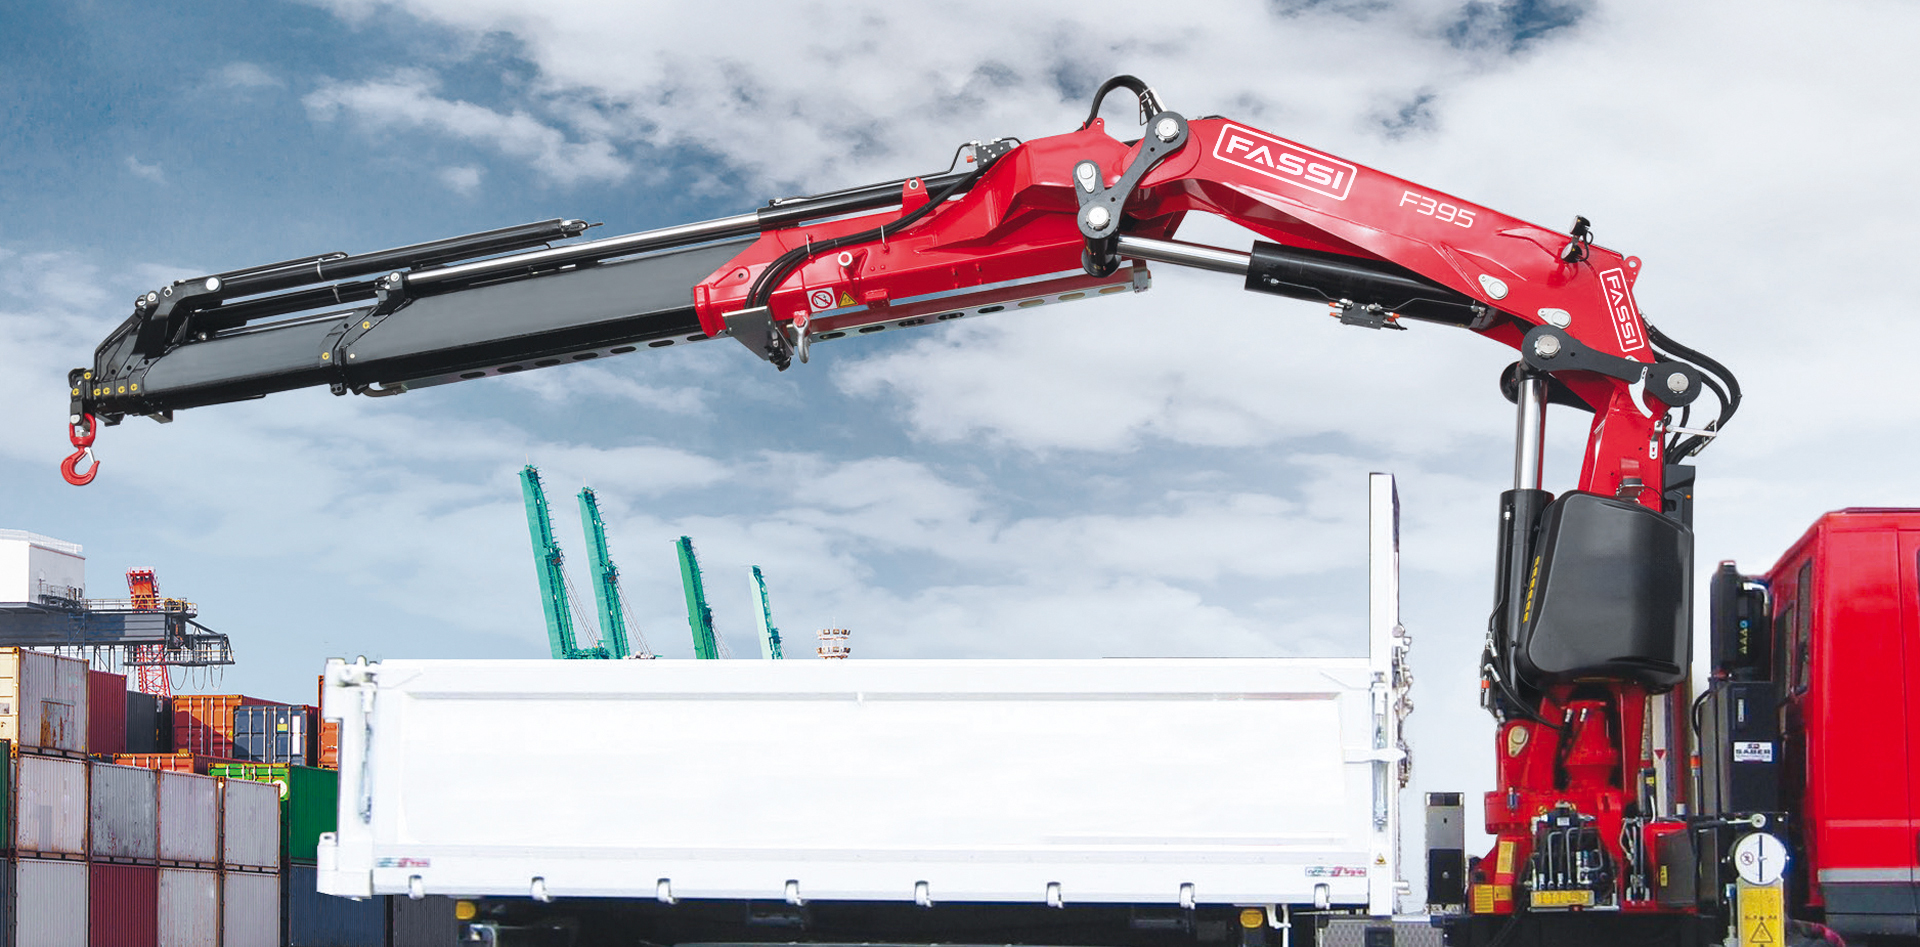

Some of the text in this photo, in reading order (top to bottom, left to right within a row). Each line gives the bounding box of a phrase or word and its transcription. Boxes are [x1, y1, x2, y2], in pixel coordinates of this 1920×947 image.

[1225, 135, 1344, 190] FASSI
[1399, 190, 1476, 228] F395
[1606, 275, 1638, 345] FASSI
